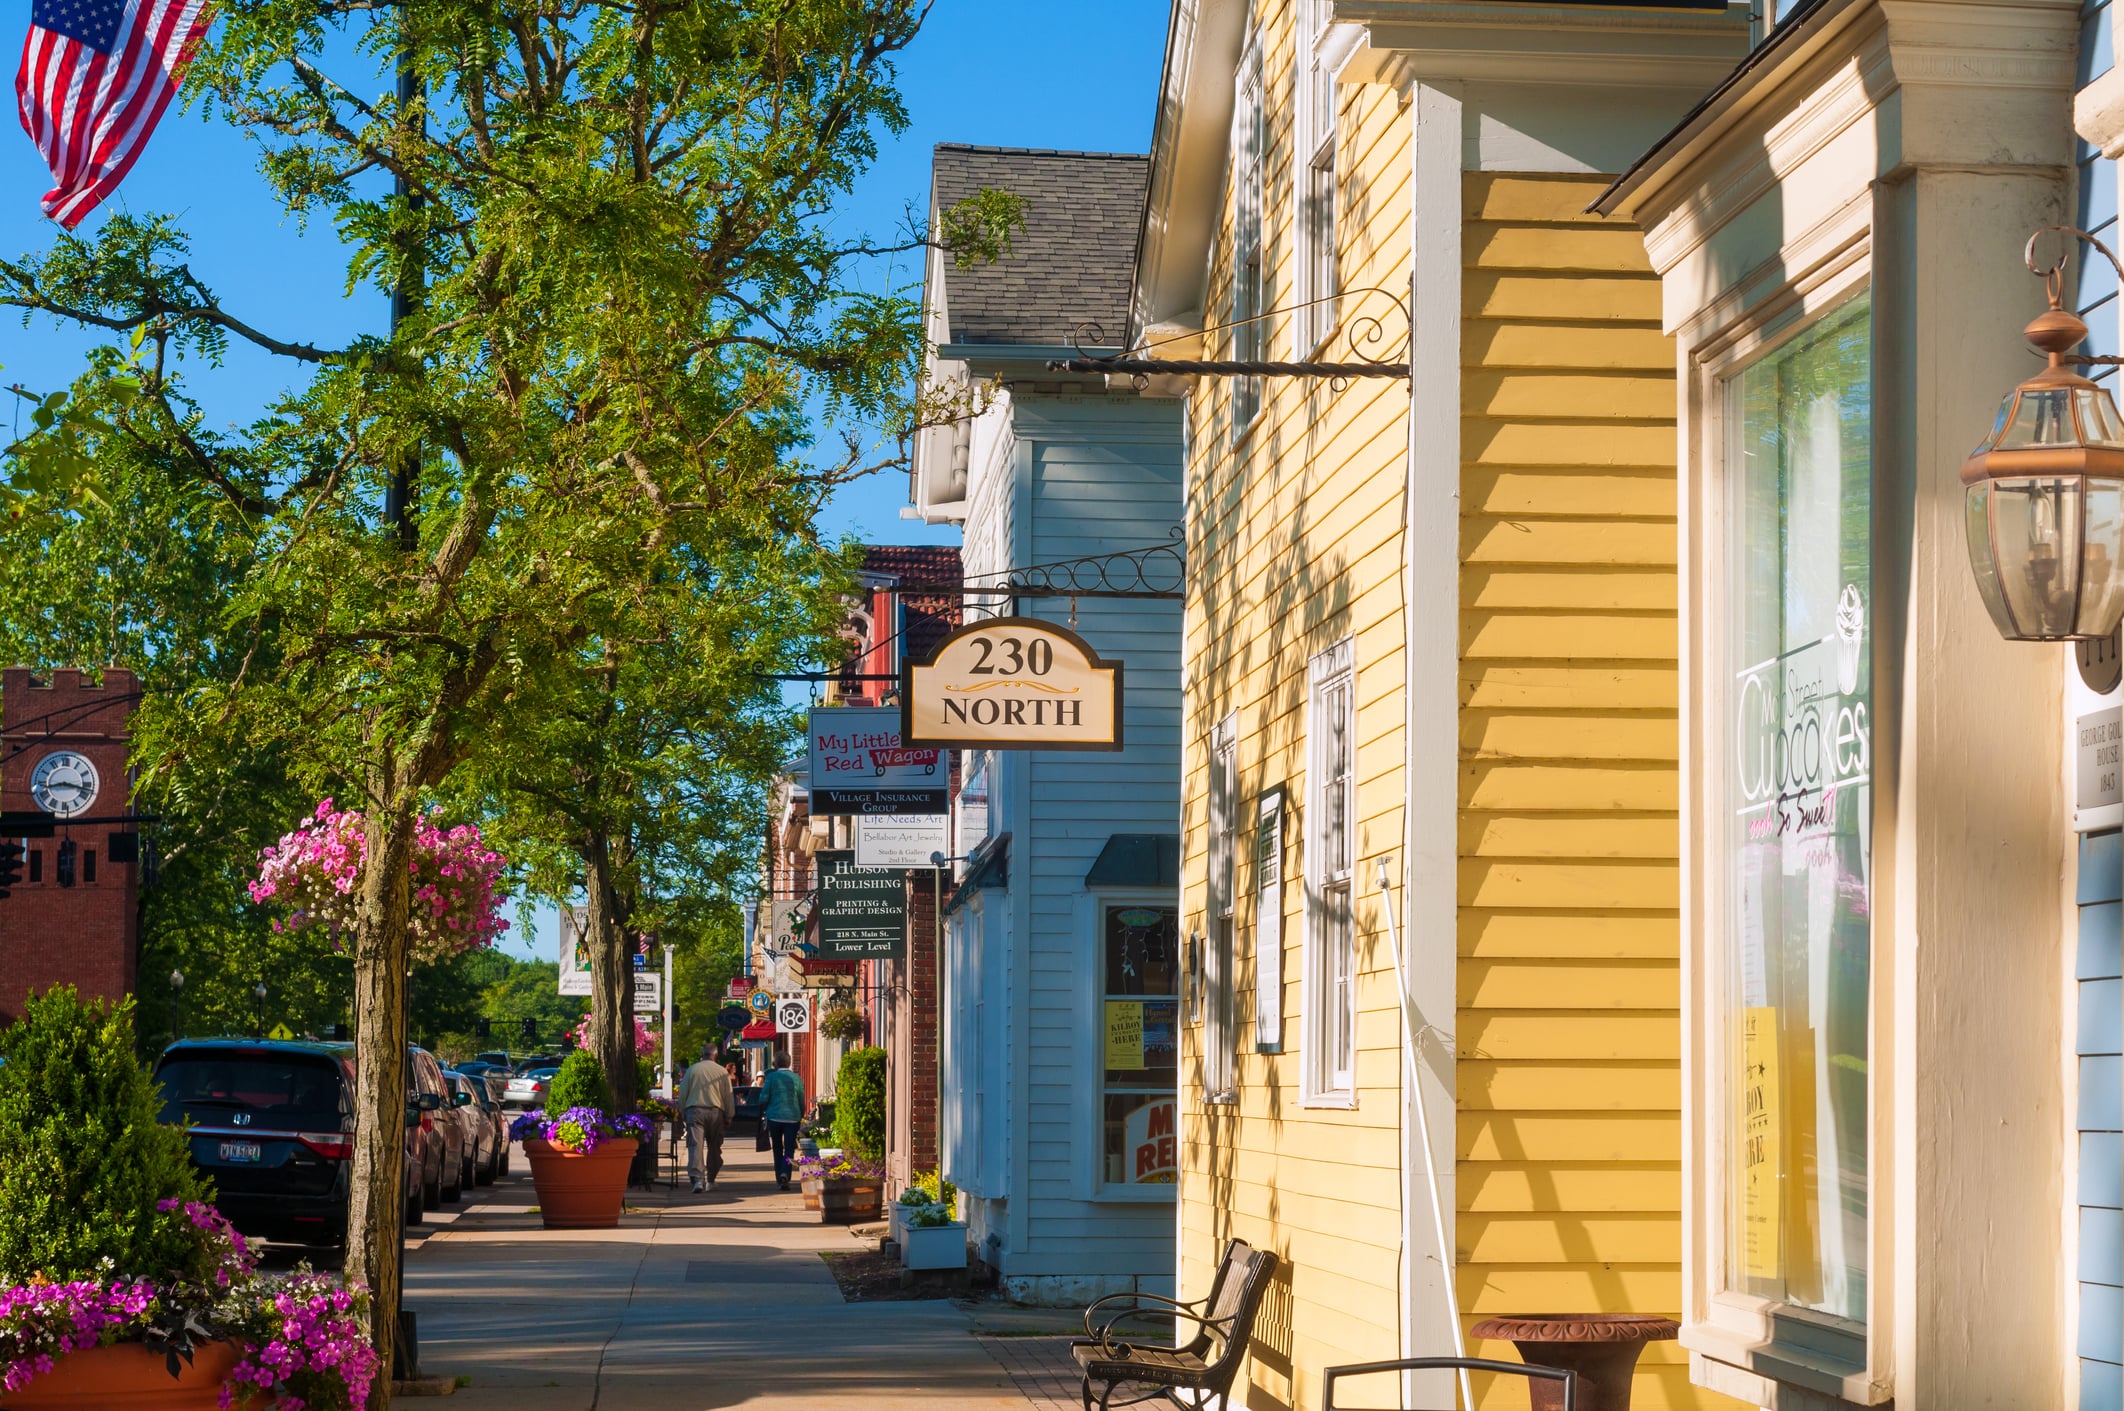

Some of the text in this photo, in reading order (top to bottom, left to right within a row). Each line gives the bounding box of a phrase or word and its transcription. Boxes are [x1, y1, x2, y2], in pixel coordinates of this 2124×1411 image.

[968, 638, 1052, 676] 230
[1788, 665, 1822, 718] Street
[941, 698, 1084, 726] NORTH
[818, 732, 900, 753] My Little
[1737, 674, 1867, 800] Cupcakes
[824, 748, 934, 772] Red Wagon
[2096, 745, 2118, 766] HOUSE
[864, 814, 943, 824] Life Needs Art
[1776, 792, 1790, 837] So
[898, 832, 913, 842] Art
[914, 833, 942, 843] Jewelry
[905, 849, 926, 857] Gallery
[822, 907, 902, 916] GRAPHIC DESIGN
[836, 900, 880, 908] PRINTING
[860, 930, 878, 938] Main
[879, 930, 890, 938] St.
[836, 942, 891, 952] Lower Level
[780, 1008, 806, 1028] 186
[1111, 1021, 1140, 1032] KILROY
[1114, 1034, 1141, 1044] HERE
